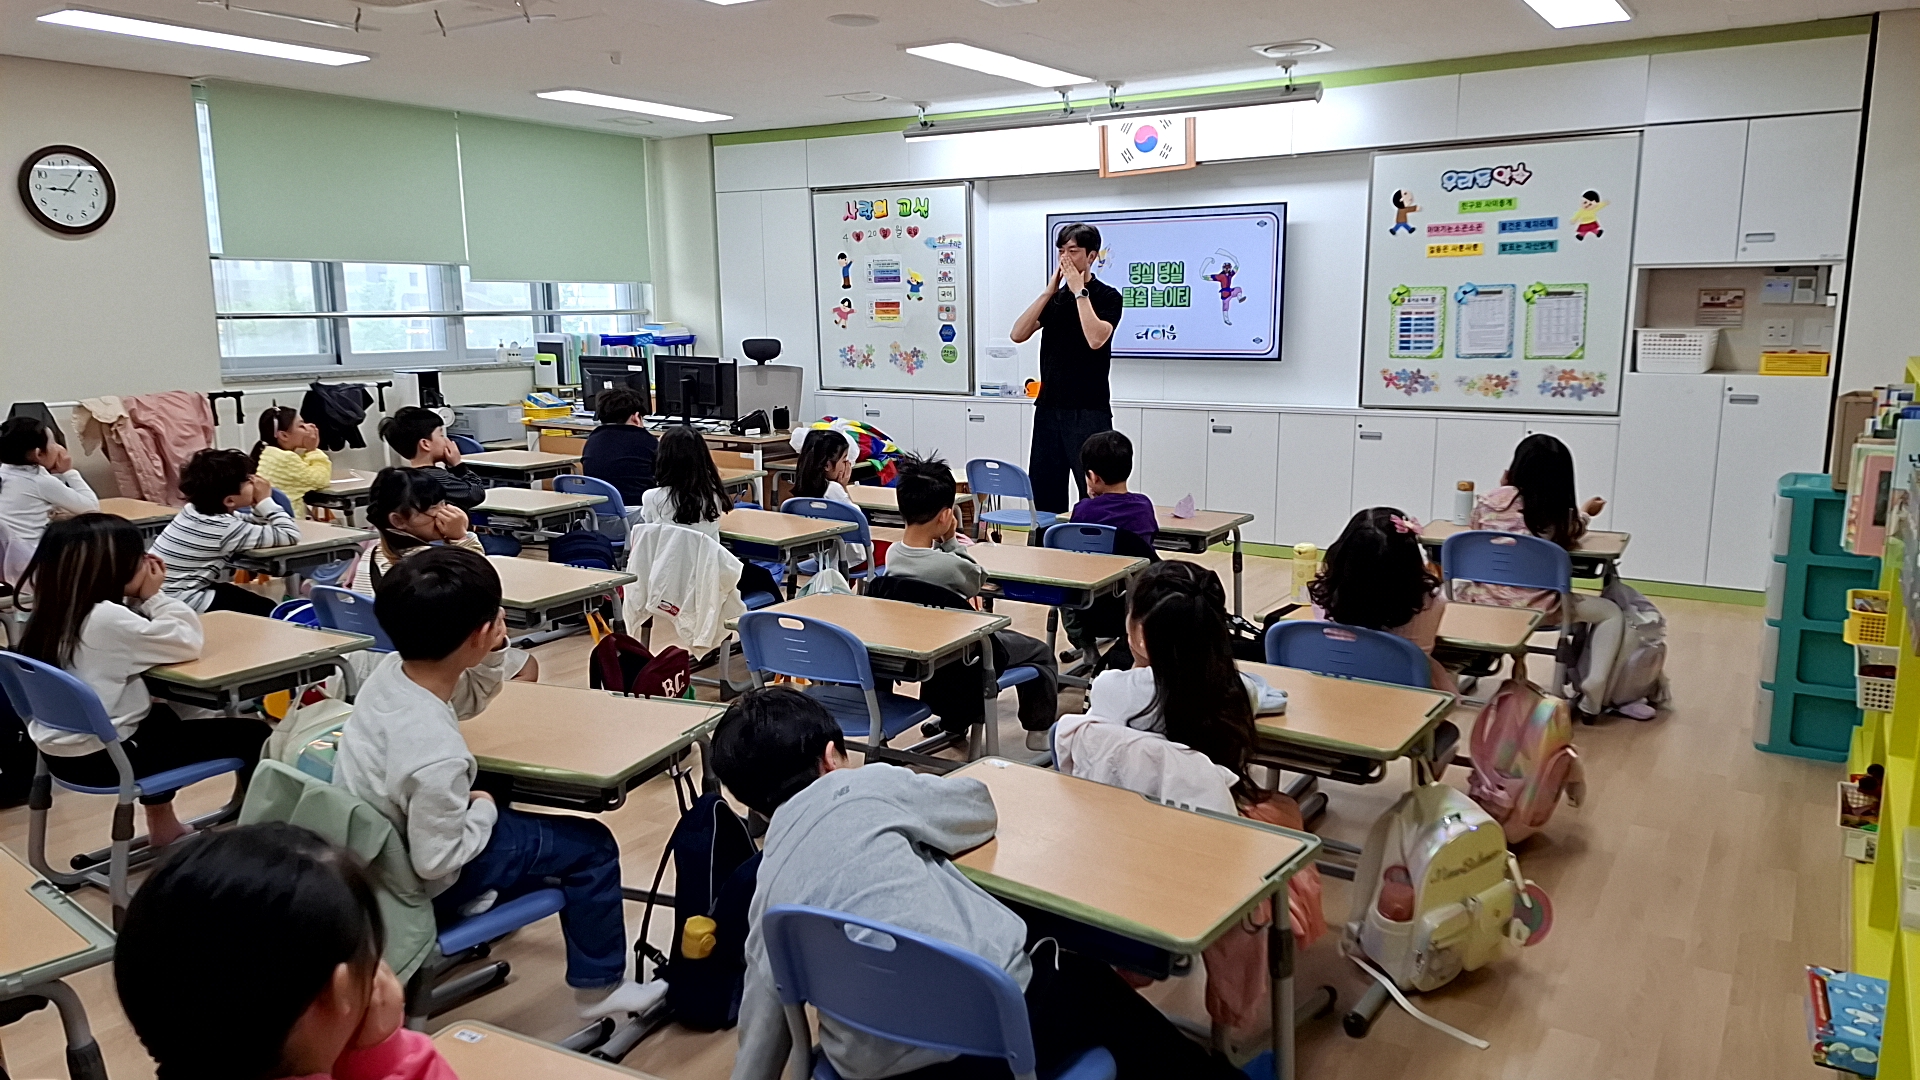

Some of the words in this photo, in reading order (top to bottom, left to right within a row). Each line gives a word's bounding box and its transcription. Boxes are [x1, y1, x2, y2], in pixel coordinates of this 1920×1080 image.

[37, 169, 48, 179] 10
[87, 174, 93, 183] 2
[34, 183, 42, 191] 9
[91, 188, 99, 197] 3
[40, 197, 48, 206] 8
[89, 201, 95, 209] 4
[52, 208, 58, 217] 7
[80, 209, 88, 218] 5
[843, 199, 889, 221] 사랑의
[897, 197, 930, 219] 교실
[66, 213, 73, 221] 6
[843, 233, 849, 243] 4
[868, 230, 877, 238] 20
[1129, 262, 1155, 285] 덩실
[1158, 261, 1184, 284] 덩실
[940, 290, 953, 298] 국어
[1122, 285, 1148, 307] 탈춤
[1151, 285, 1191, 307] 놀이터
